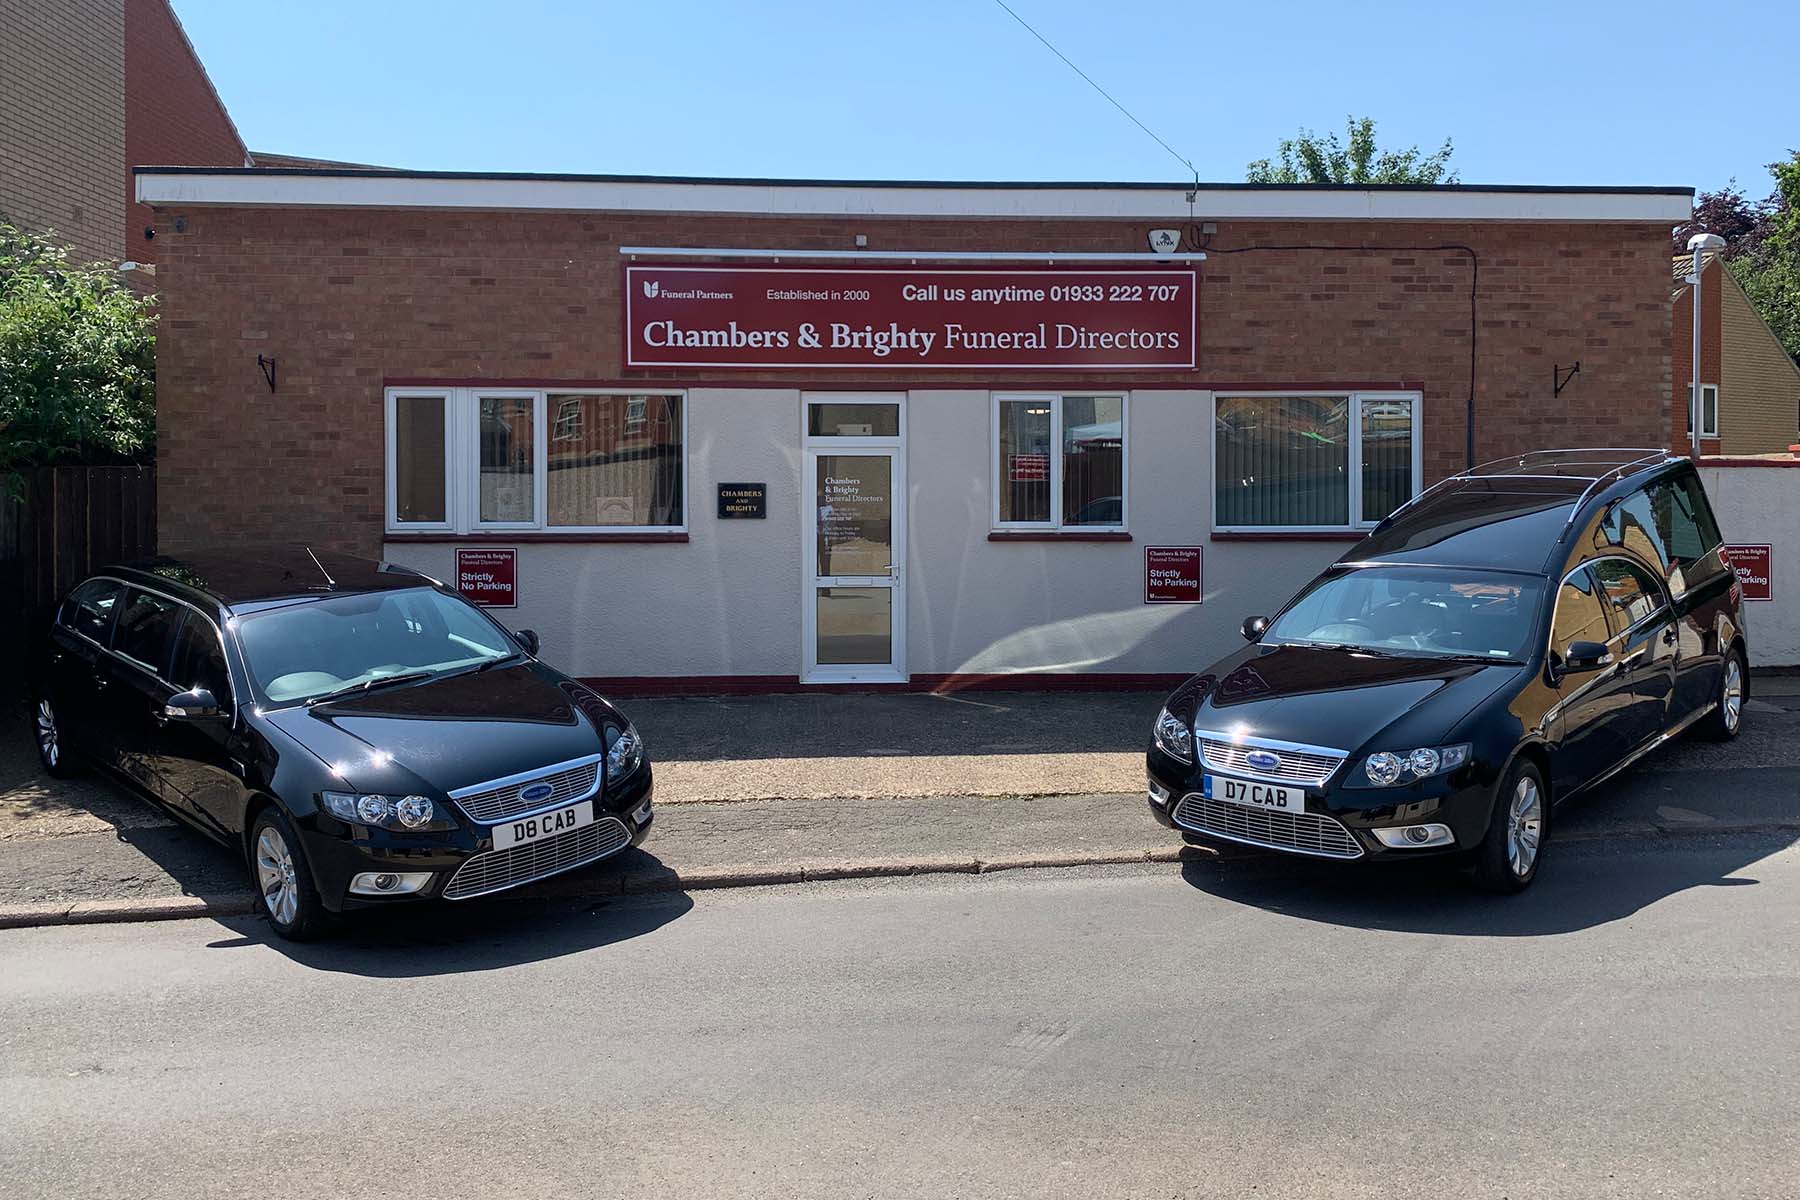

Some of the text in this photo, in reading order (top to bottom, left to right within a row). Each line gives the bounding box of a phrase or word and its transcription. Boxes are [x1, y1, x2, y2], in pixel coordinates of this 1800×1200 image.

[661, 289, 734, 300] Funeral Partners
[766, 289, 870, 301] Established in 2000
[902, 284, 1180, 305] Call us anytime 01933 222 707
[643, 320, 1180, 357] Chambers & Brighty Funeral Directors
[824, 476, 861, 485] Chambers
[824, 485, 860, 495] & Brighty
[825, 494, 884, 502] Funeral Directors
[461, 572, 494, 582] Strictly
[1150, 569, 1181, 579] Strictly
[461, 581, 512, 592] No Parking
[1150, 578, 1198, 589] No Parking
[1225, 780, 1288, 808] D7 CAB
[513, 808, 576, 842] D8 CAB
